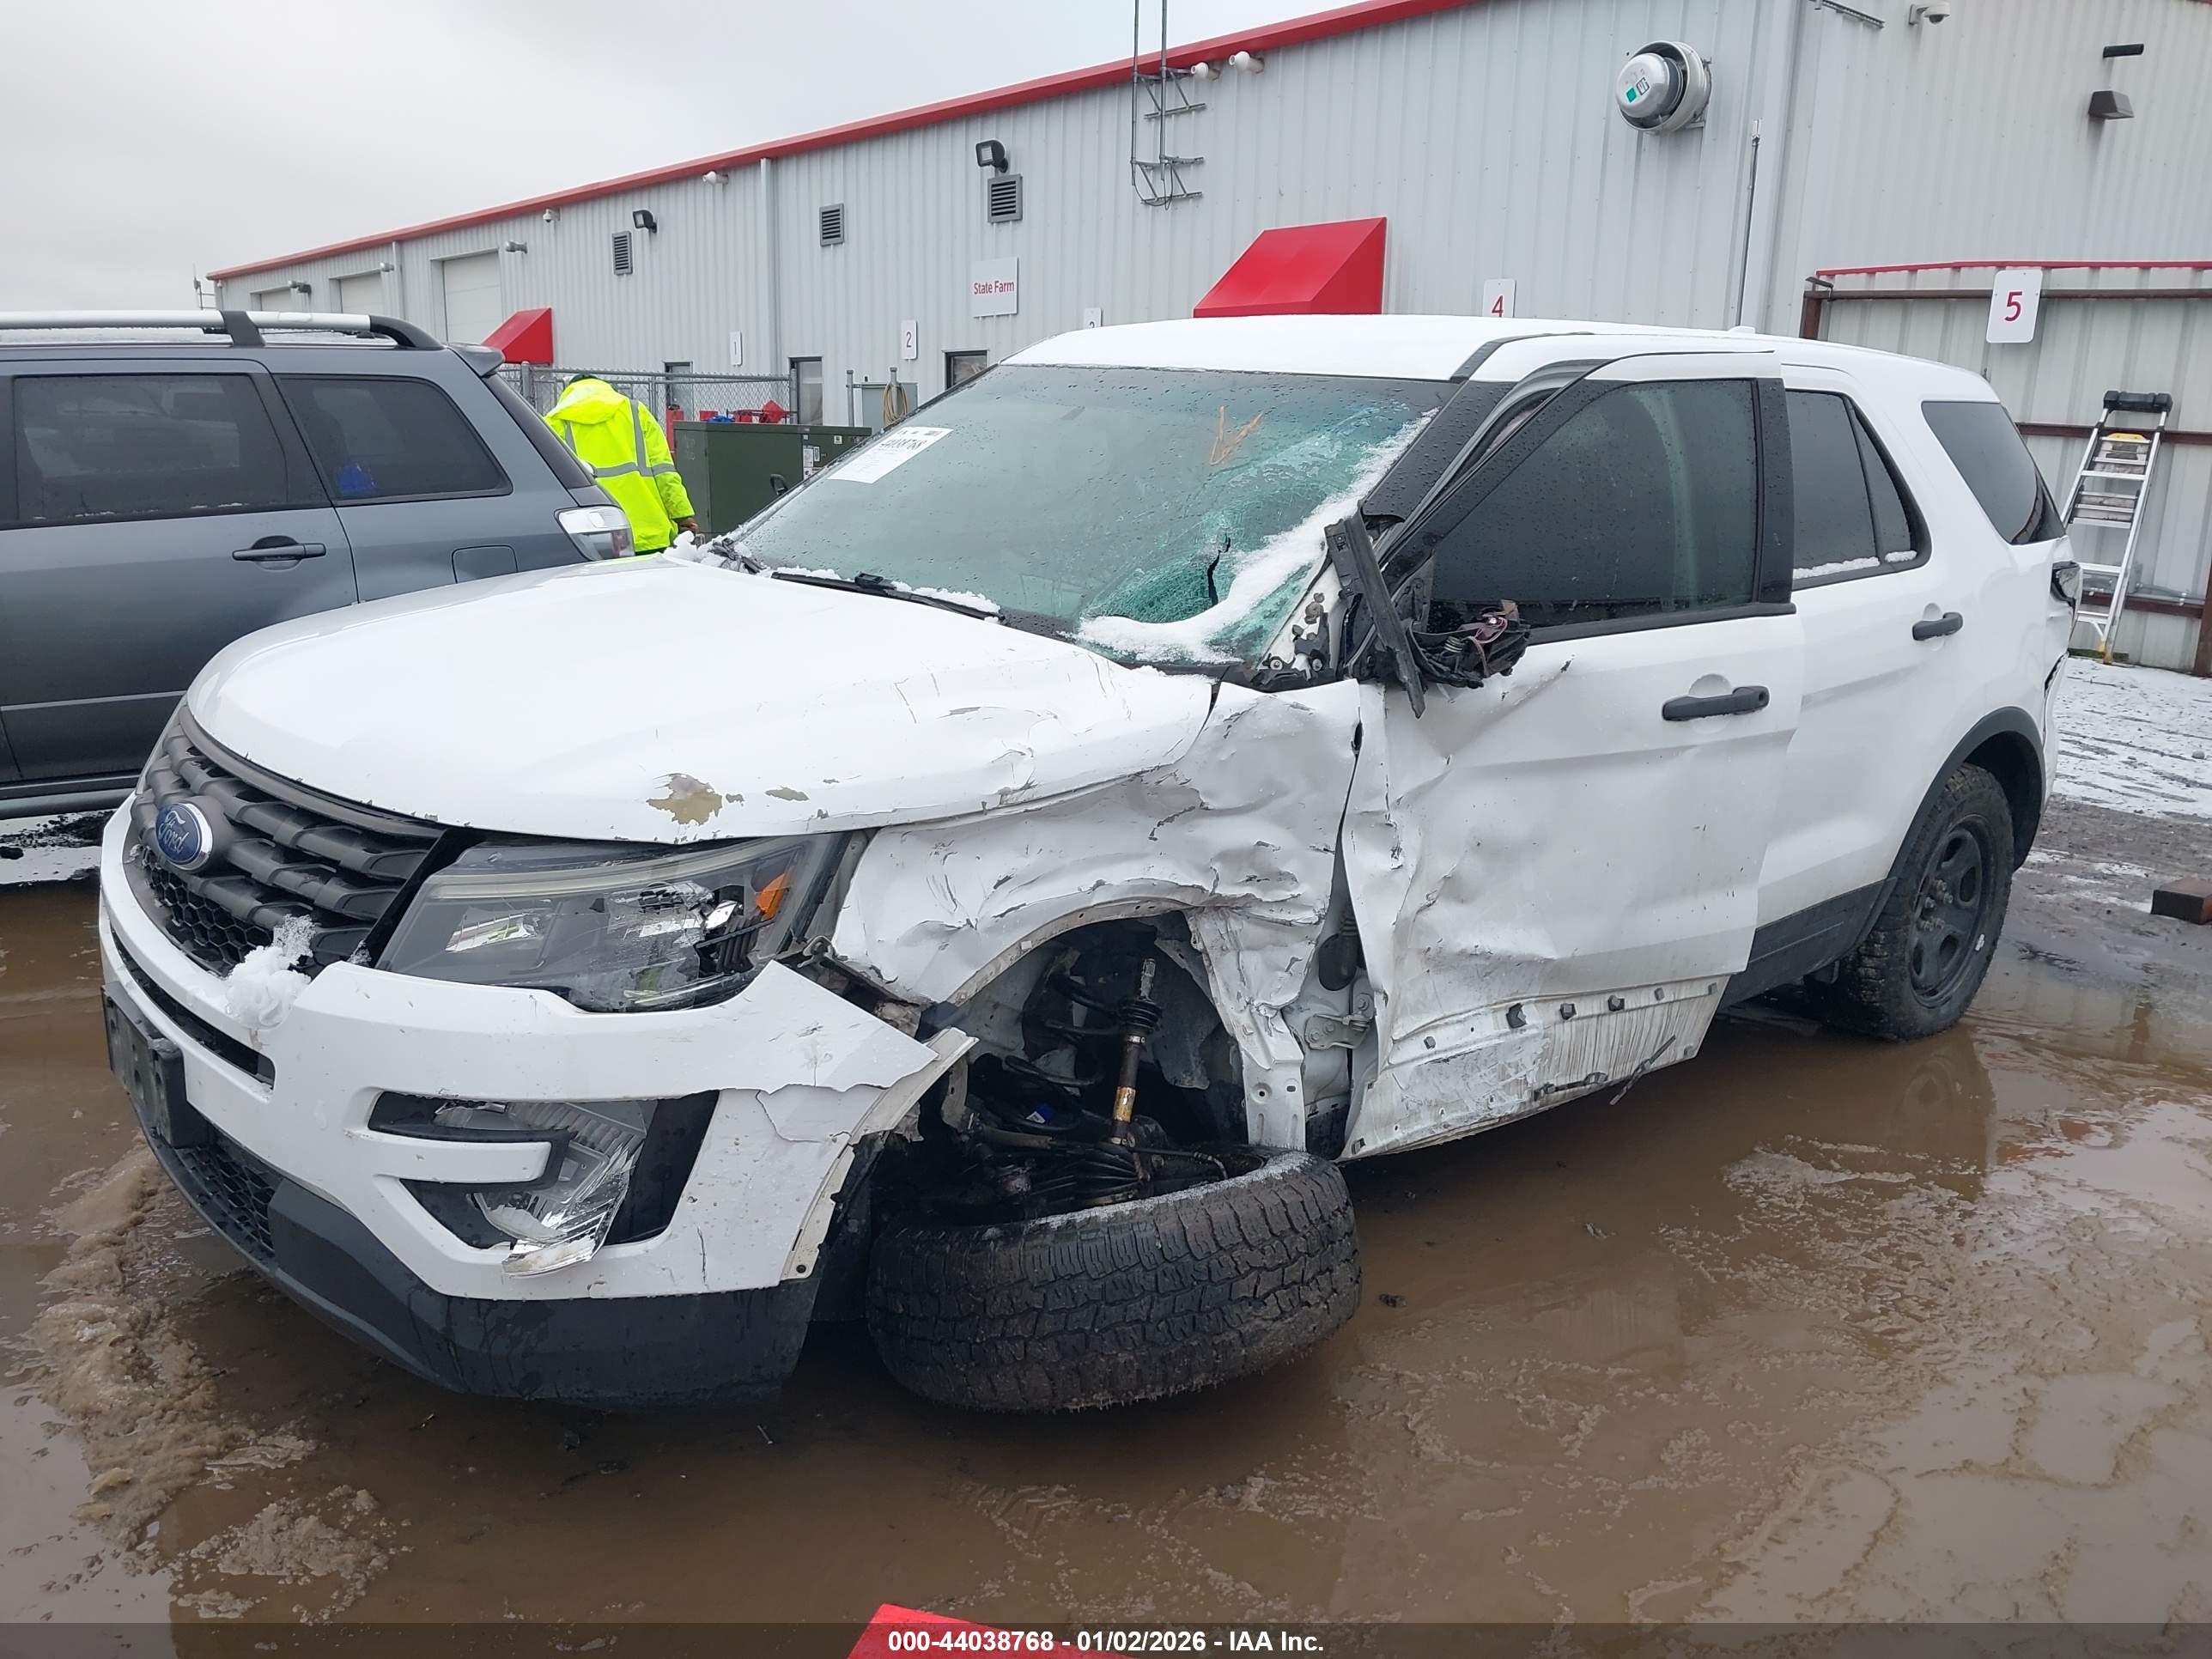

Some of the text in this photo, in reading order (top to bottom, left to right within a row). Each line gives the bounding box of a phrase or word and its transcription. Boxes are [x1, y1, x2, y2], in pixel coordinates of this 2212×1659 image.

[974, 280, 1015, 295] State Farm
[1492, 295, 1504, 318] 4
[2004, 291, 2023, 322] 5
[906, 331, 912, 348] 2
[158, 810, 190, 854] Ford
